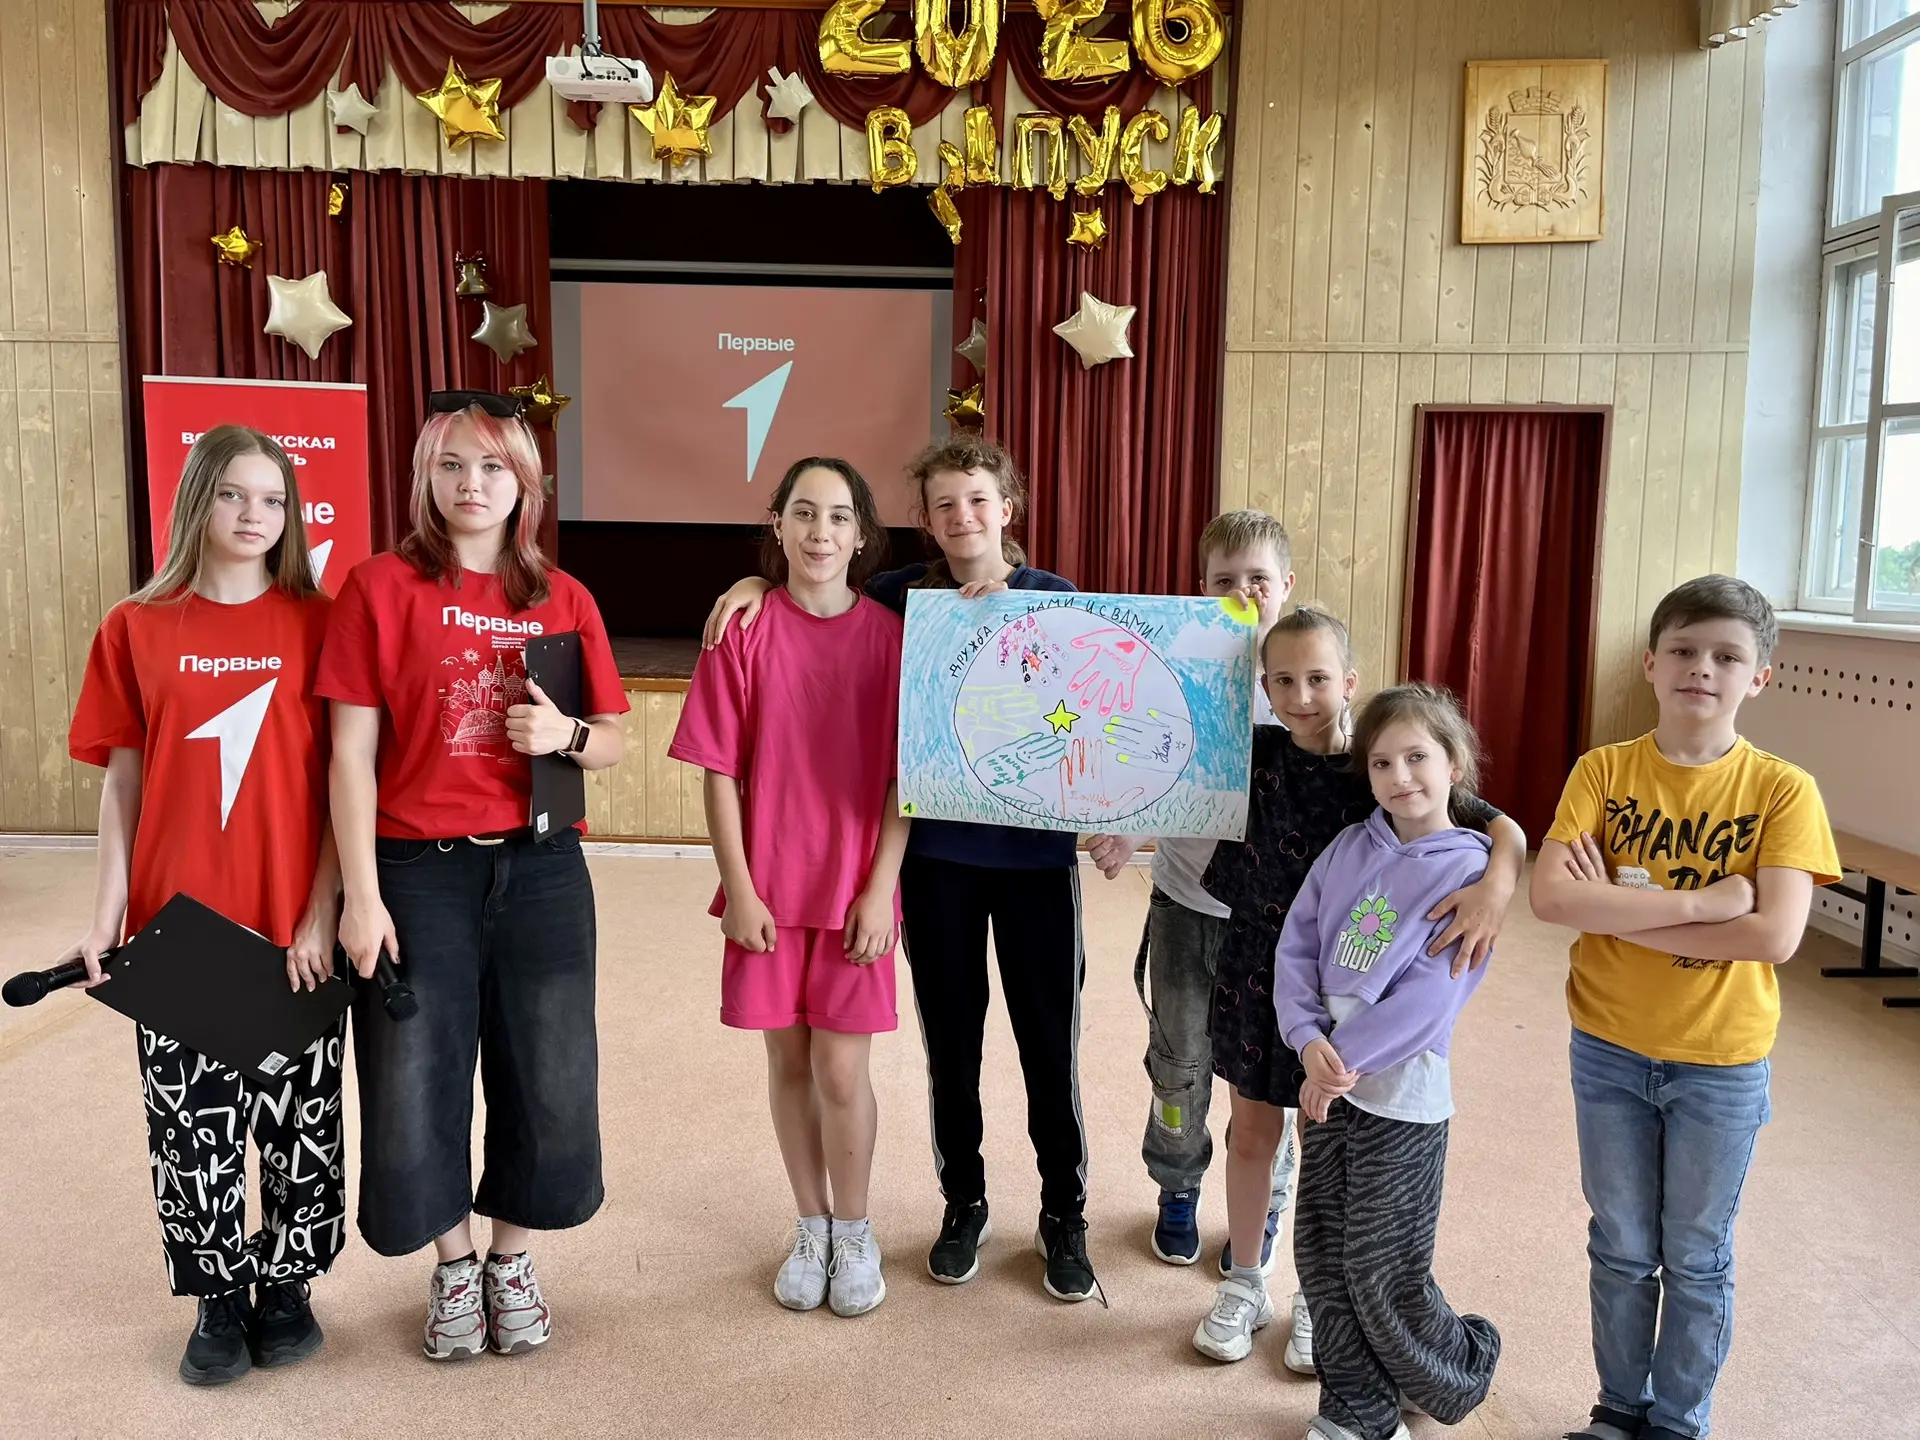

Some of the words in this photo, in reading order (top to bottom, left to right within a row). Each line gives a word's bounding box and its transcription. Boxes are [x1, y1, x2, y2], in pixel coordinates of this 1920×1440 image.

[819, 0, 1227, 88] 2026
[718, 332, 795, 356] Первые
[441, 606, 544, 635] Первые
[179, 654, 282, 678] Первые
[1609, 808, 1760, 875] CHANGE
